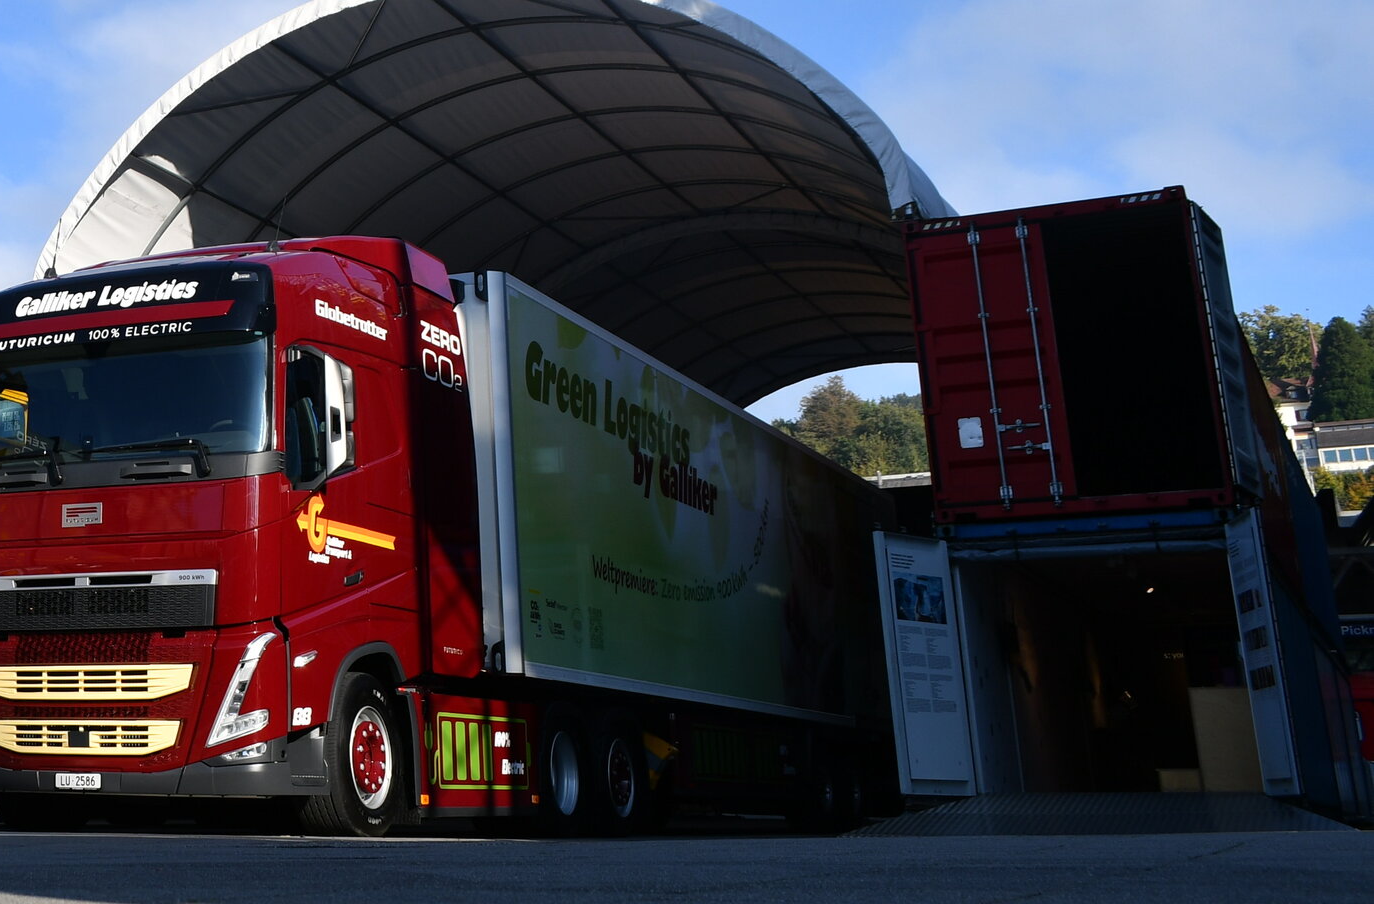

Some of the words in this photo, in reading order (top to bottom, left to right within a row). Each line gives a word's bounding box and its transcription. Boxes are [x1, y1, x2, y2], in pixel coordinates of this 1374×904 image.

[15, 290, 96, 318] Galliker
[97, 279, 199, 308] Logistics
[88, 328, 120, 341] 100%
[125, 321, 193, 337] ELECTRIC
[315, 299, 388, 341] Globetrotter
[420, 320, 461, 356] ZERO
[525, 341, 597, 427] Green
[604, 379, 690, 467] Logistics
[633, 450, 654, 499] by
[659, 455, 718, 516] Galliker
[592, 554, 658, 597] Weltpremiere:
